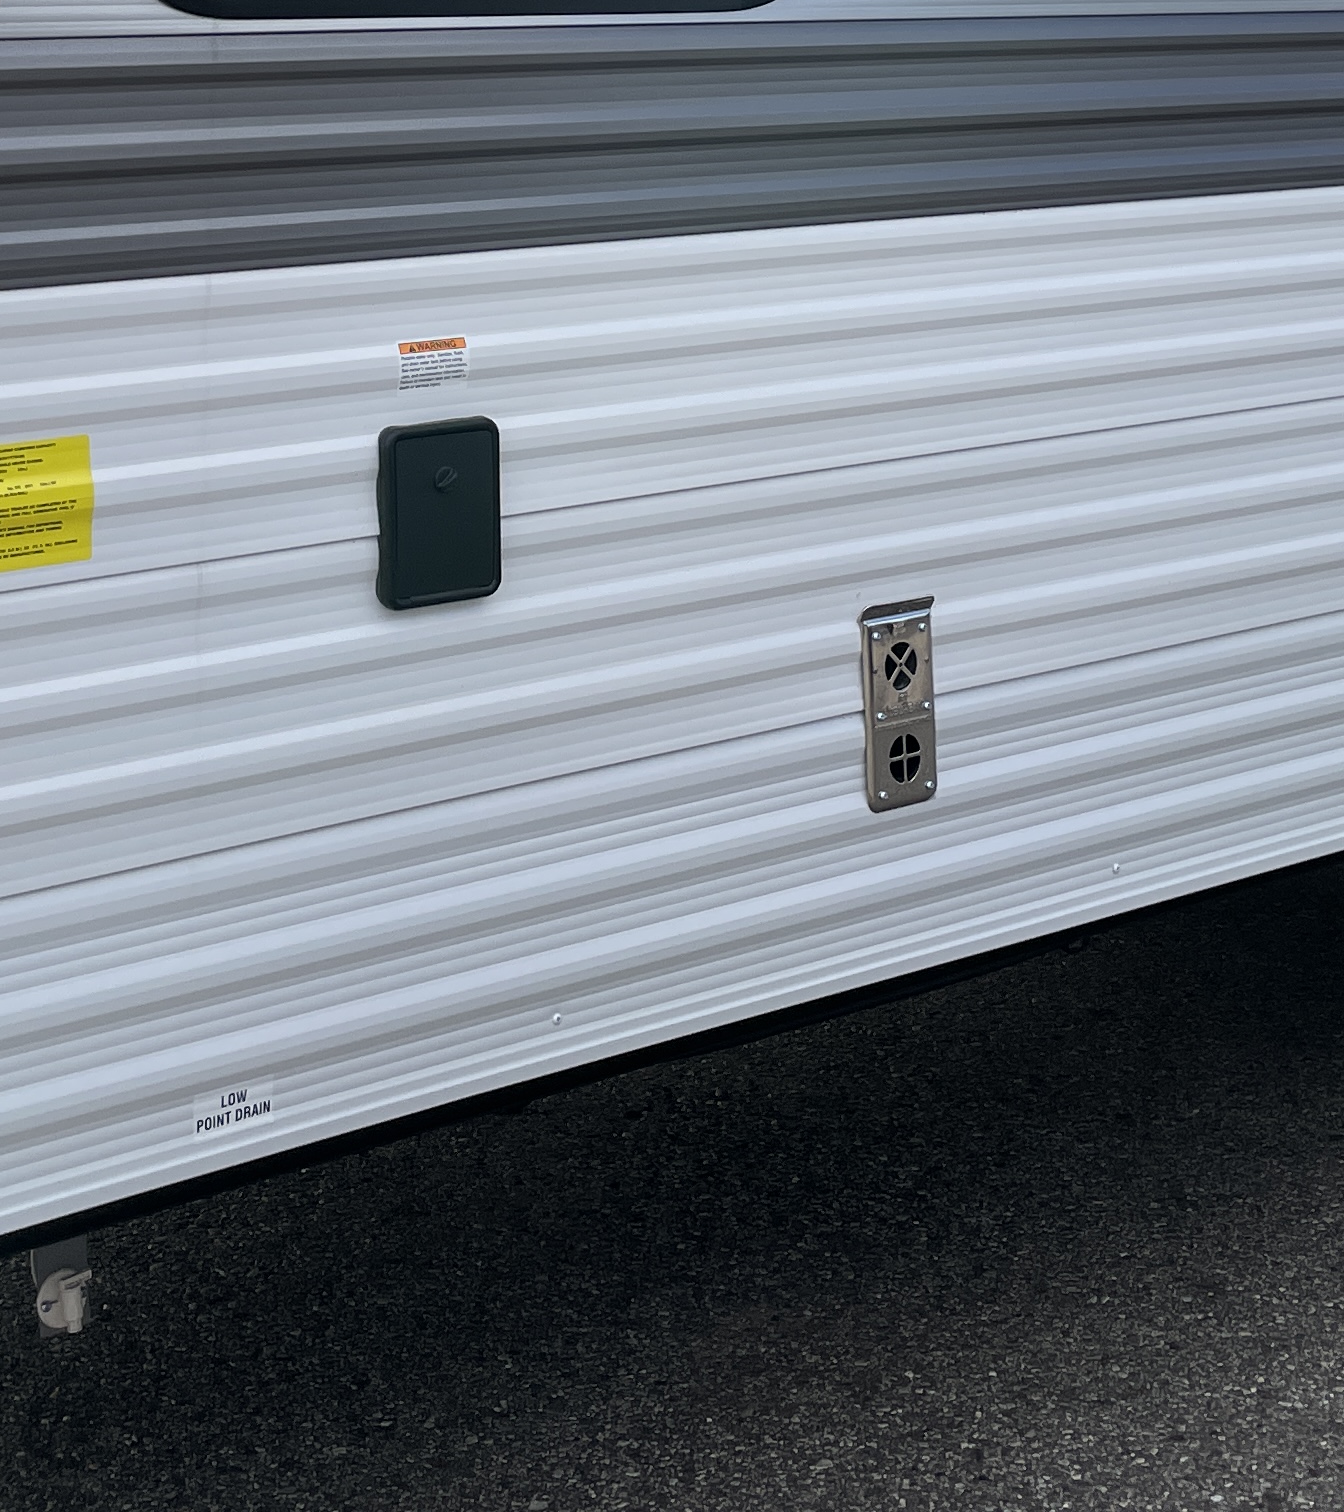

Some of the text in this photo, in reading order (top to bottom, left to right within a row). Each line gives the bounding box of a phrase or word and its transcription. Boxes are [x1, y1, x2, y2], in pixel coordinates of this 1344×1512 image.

[416, 339, 457, 352] WARNING
[221, 1089, 248, 1108] LOW
[196, 1100, 271, 1133] POINT DRAIN
